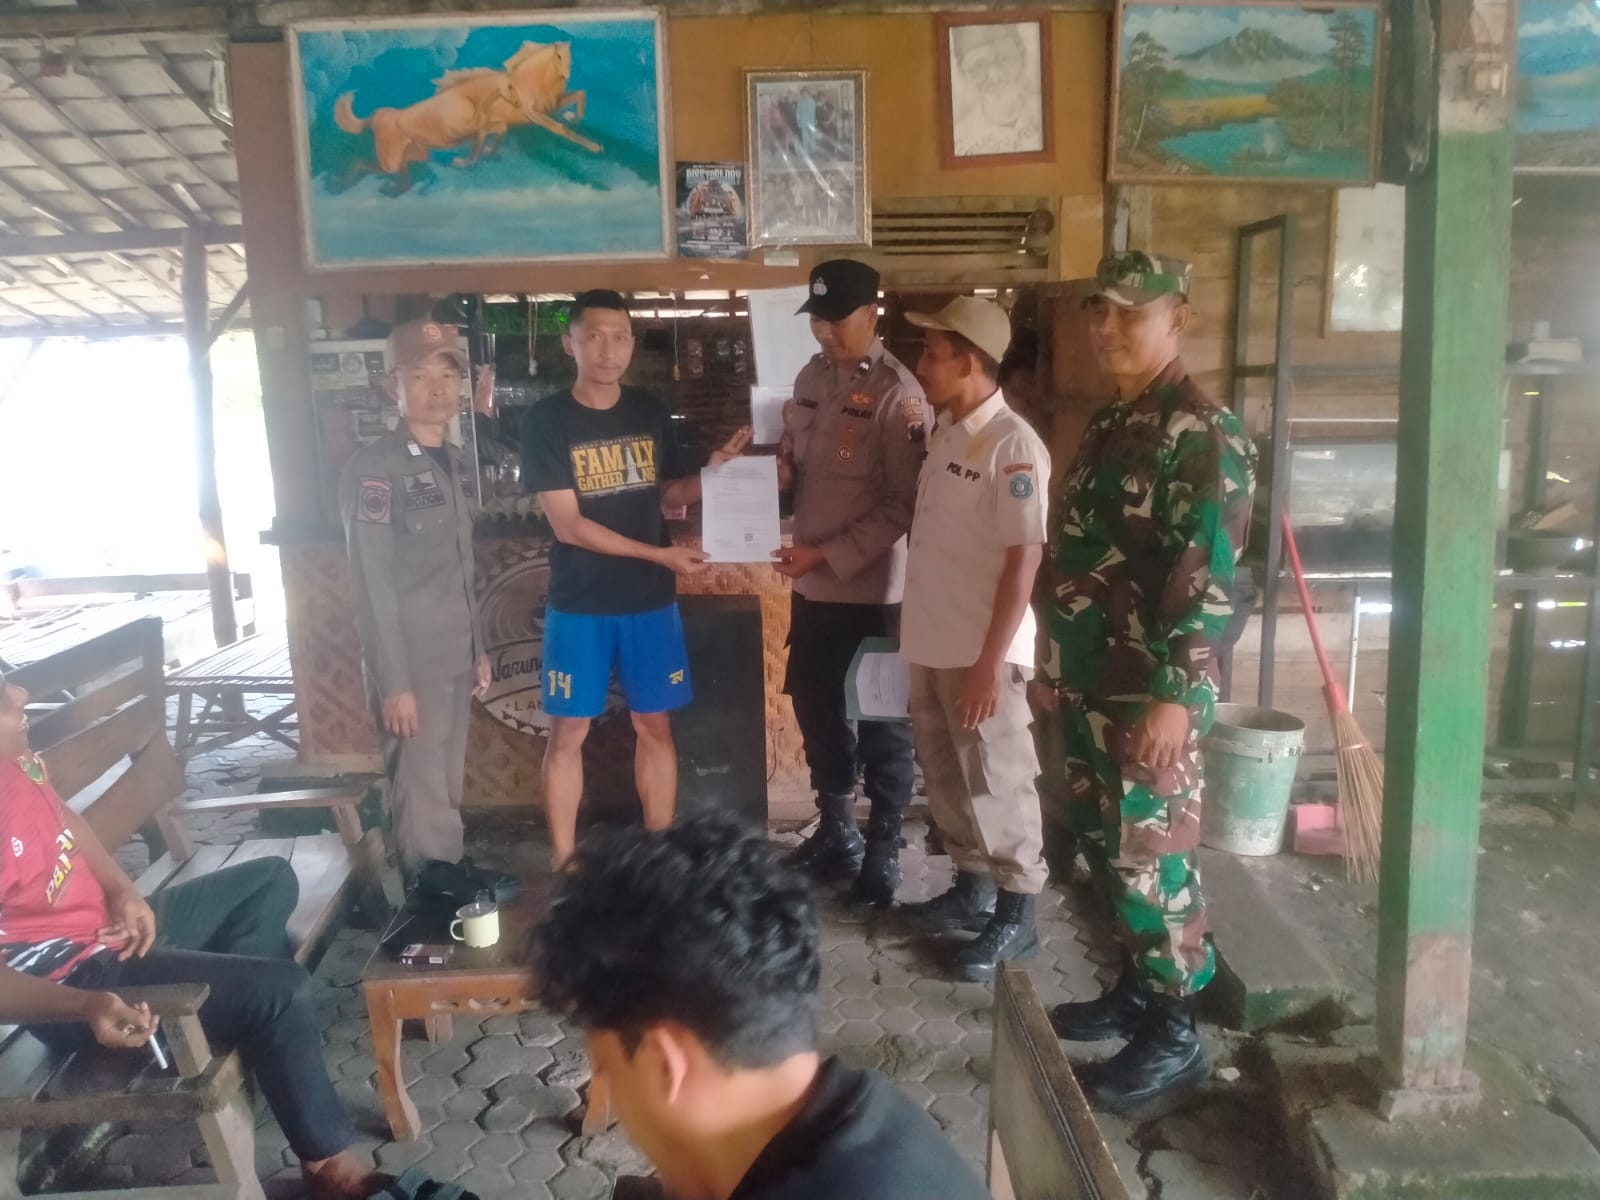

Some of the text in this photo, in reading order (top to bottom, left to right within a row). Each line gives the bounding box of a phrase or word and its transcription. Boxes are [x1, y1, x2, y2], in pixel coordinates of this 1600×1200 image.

[572, 440, 654, 477] FAMILY
[964, 469, 981, 482] PP
[547, 669, 572, 699] 14
